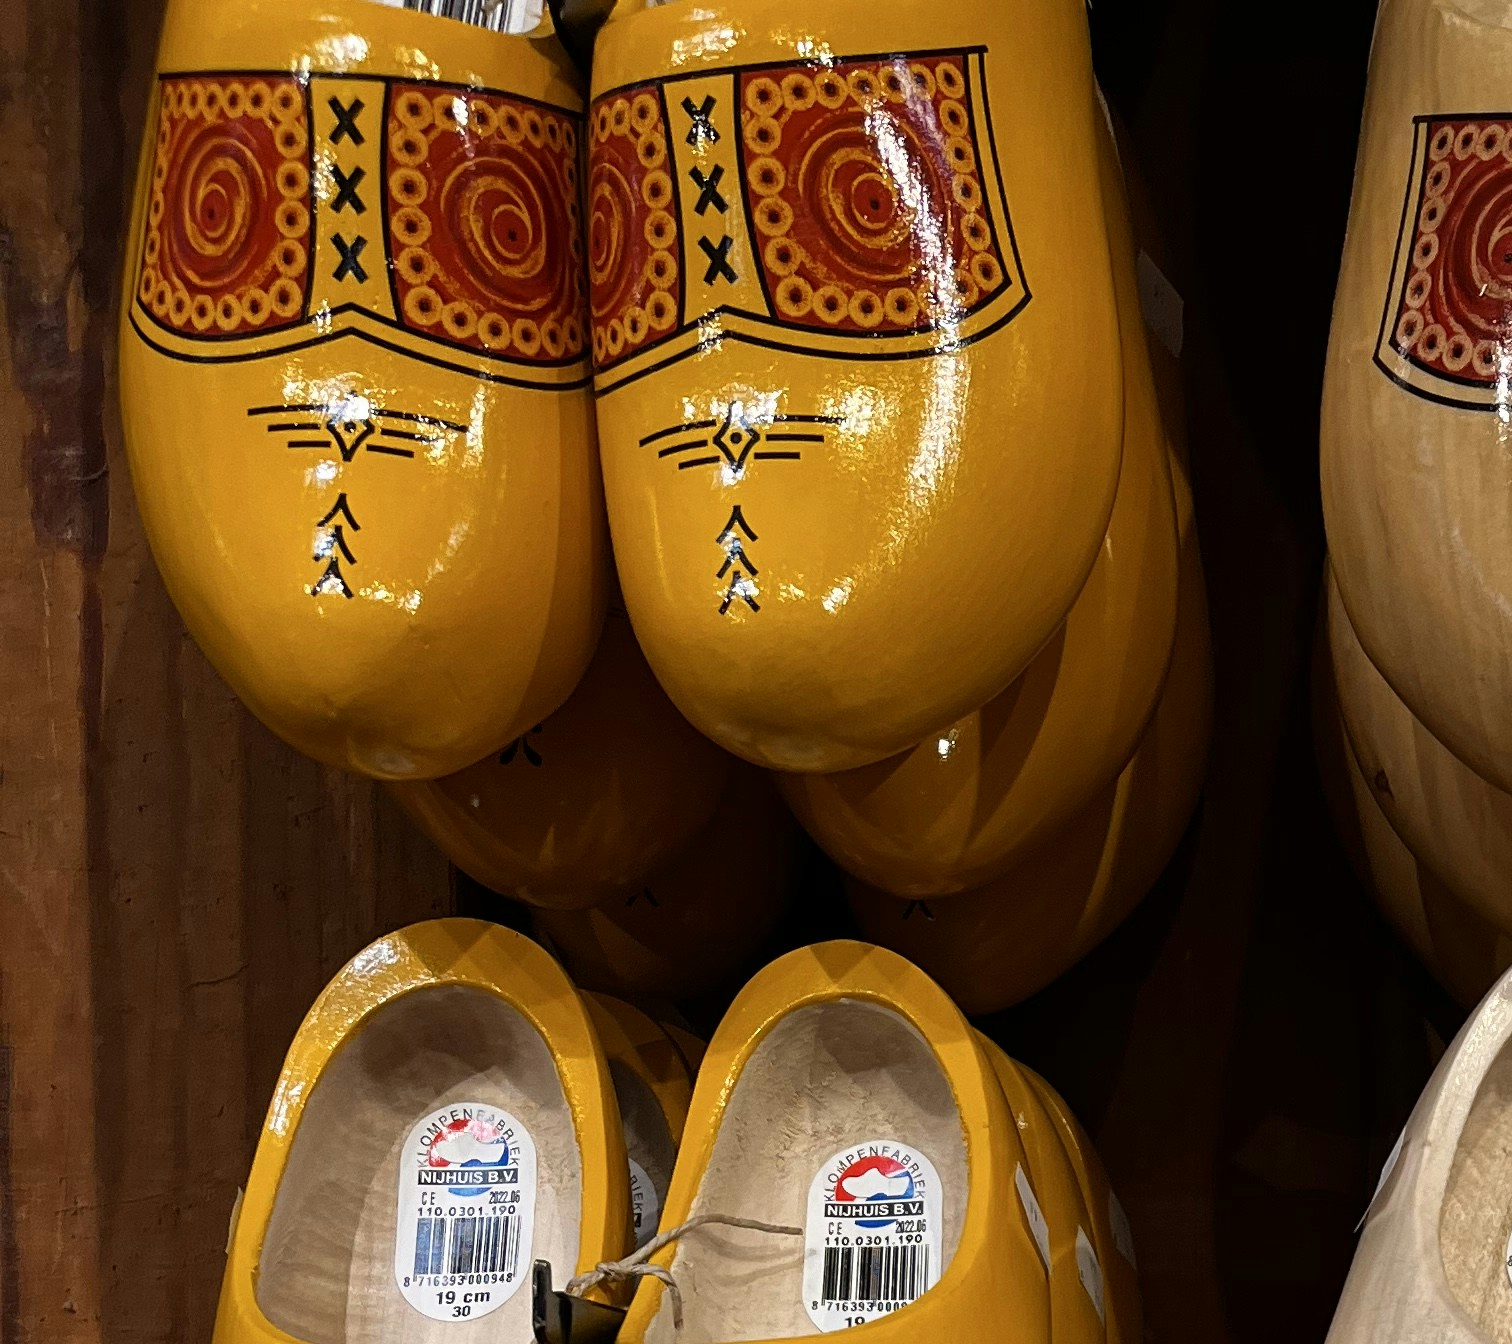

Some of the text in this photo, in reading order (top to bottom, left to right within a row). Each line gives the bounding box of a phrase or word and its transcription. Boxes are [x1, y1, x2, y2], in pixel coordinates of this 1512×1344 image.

[421, 1170, 516, 1184] NIJHUIS B.V.
[825, 1146, 926, 1202] KLOMPENFABRIEK
[418, 1205, 516, 1216] 110.0301.190
[827, 1203, 921, 1216] NIJHUIS B.V.
[825, 1235, 922, 1246] 110.0301.190
[437, 1291, 490, 1304] 19 cm
[452, 1306, 470, 1317] 30
